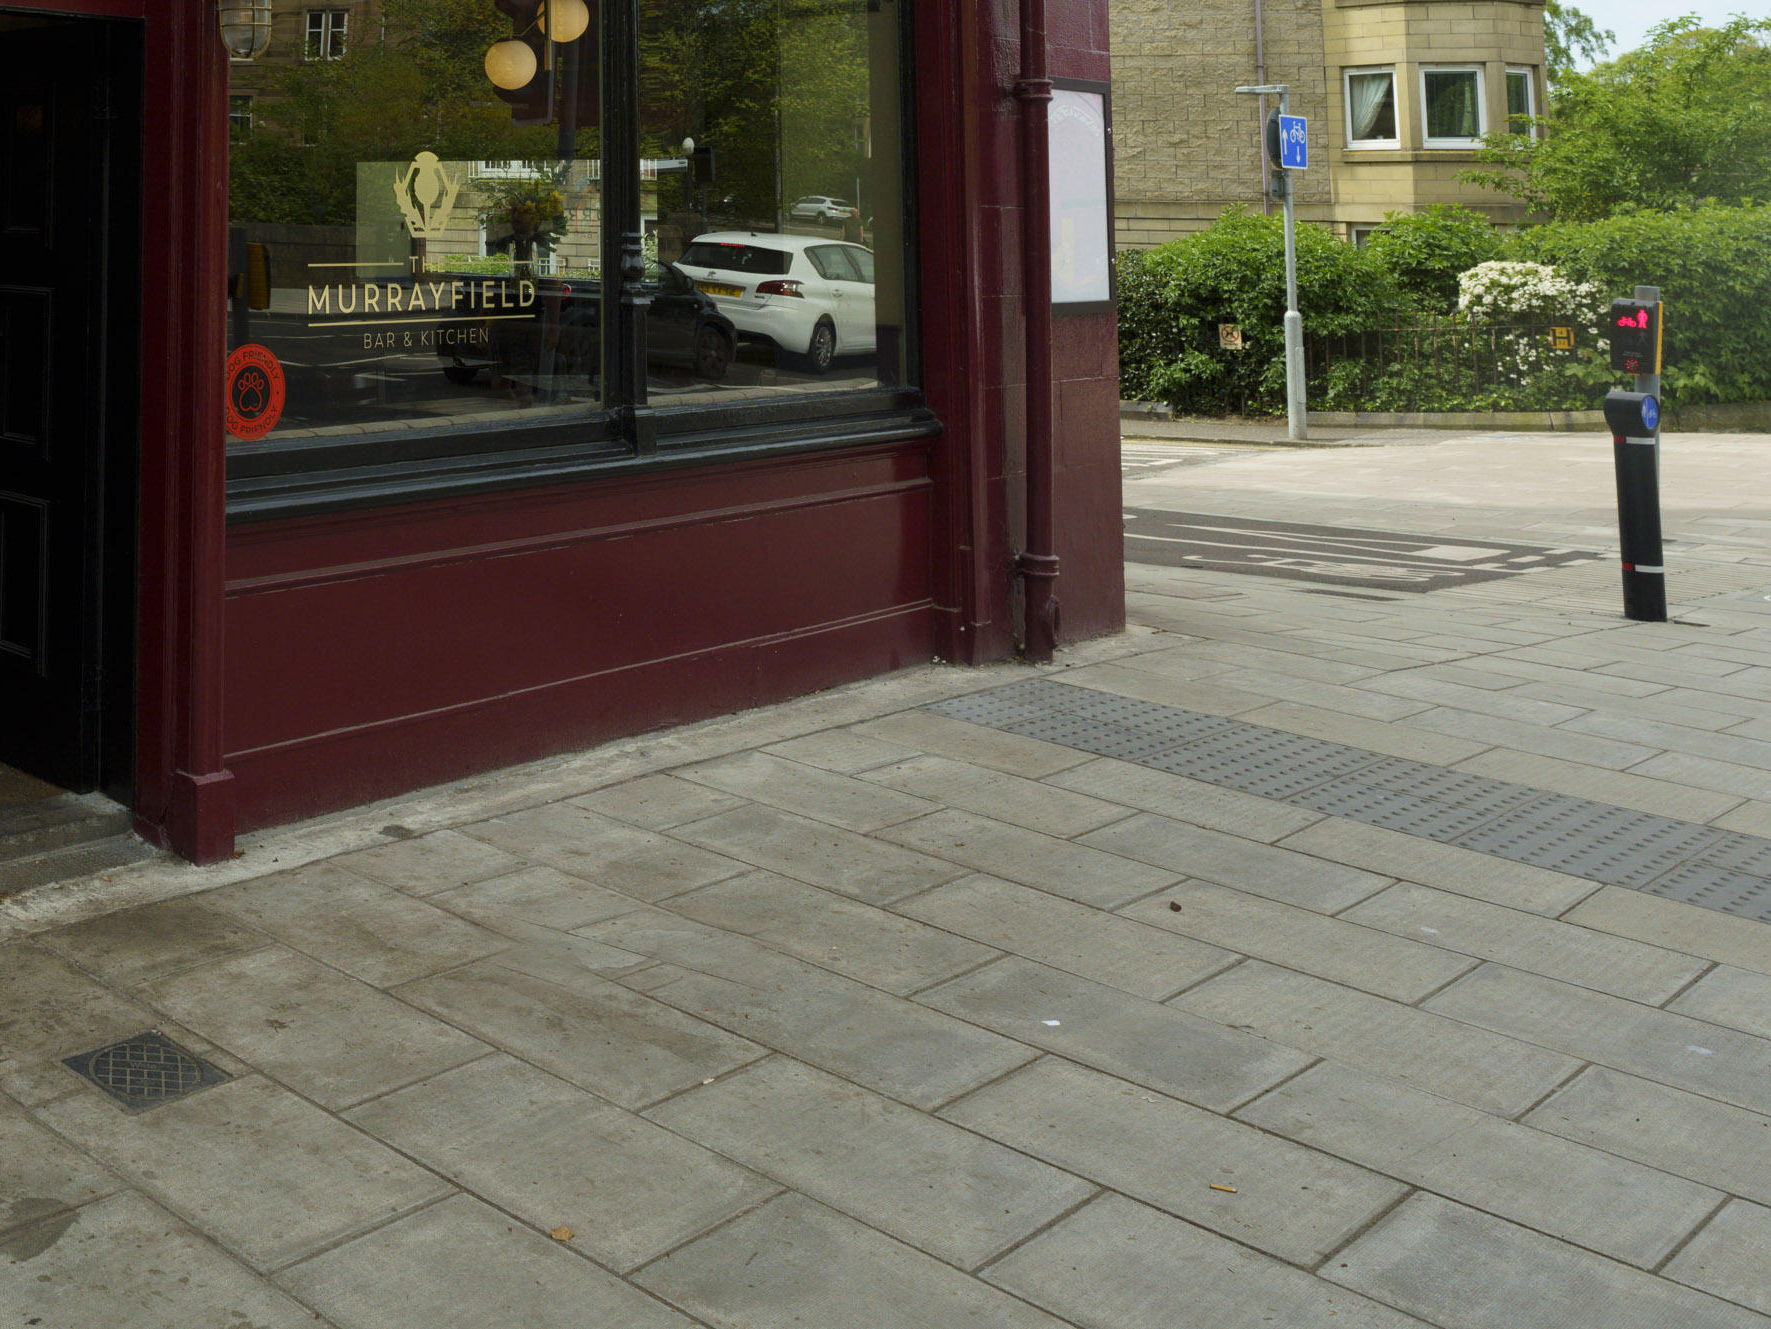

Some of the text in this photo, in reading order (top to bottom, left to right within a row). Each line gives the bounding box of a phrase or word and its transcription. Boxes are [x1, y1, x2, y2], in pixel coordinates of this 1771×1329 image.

[408, 255, 446, 274] THE
[307, 280, 537, 315] MURRAYFIELD
[363, 327, 490, 350] BAR & KITCHEN
[242, 350, 280, 379] FRIENDLY
